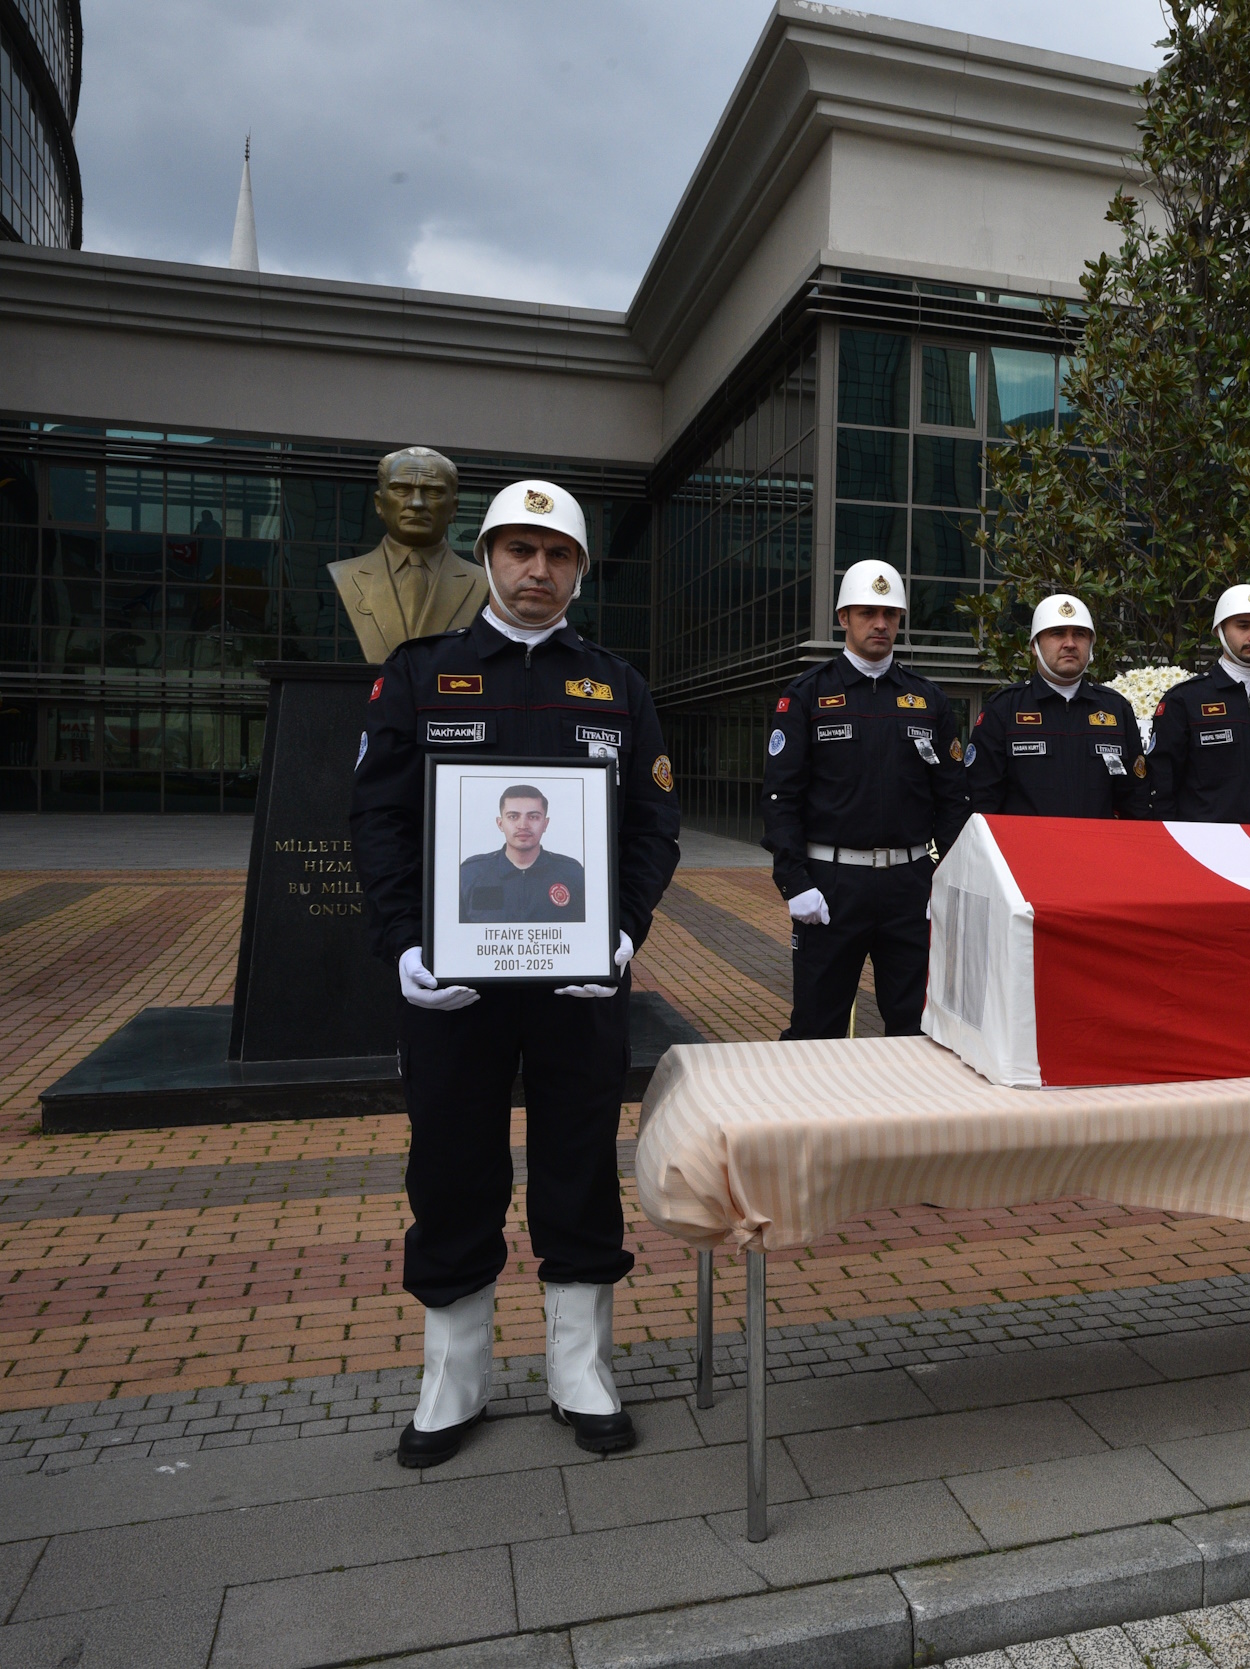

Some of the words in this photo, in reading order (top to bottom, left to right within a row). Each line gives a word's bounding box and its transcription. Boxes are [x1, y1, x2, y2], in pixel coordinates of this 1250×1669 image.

[582, 728, 616, 742] İTFAİYE
[275, 839, 352, 852] MİLLETE
[304, 859, 353, 872] HİZM
[288, 882, 311, 895] BU
[321, 881, 364, 893] MİLL
[309, 903, 362, 915] ONUN
[485, 927, 524, 940] İTFAİYE
[527, 926, 562, 943] ŞEHİDİ
[476, 944, 514, 956] BURAK
[517, 941, 570, 955] DAĞTEKİN
[494, 959, 554, 971] 2001-2025
